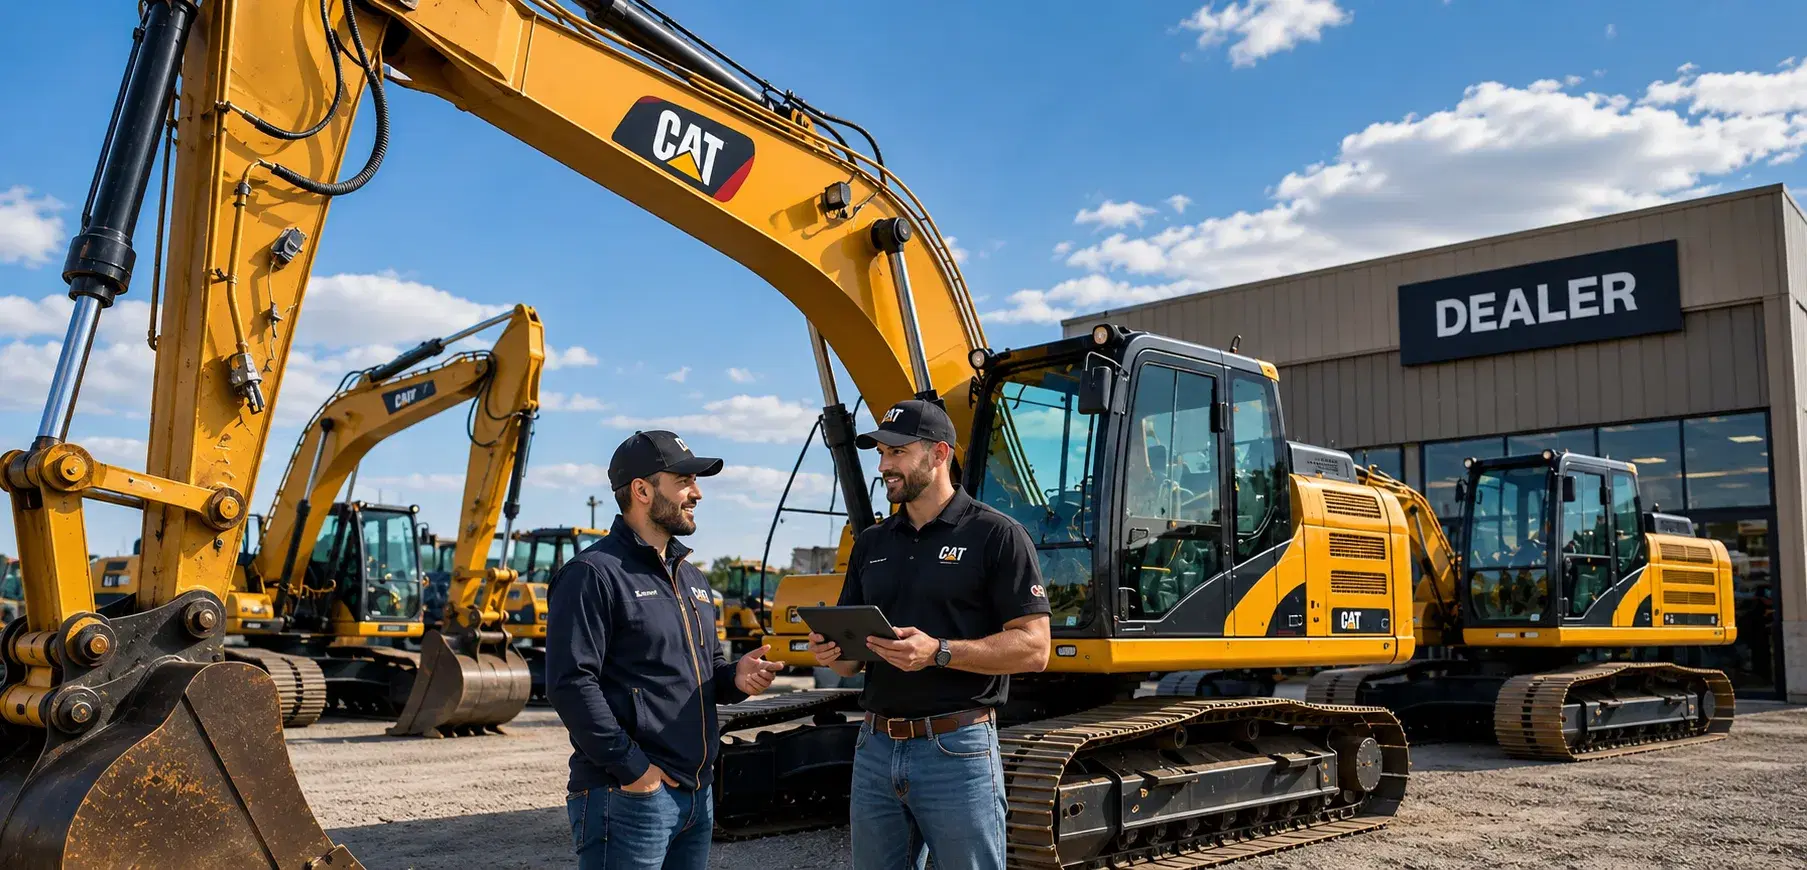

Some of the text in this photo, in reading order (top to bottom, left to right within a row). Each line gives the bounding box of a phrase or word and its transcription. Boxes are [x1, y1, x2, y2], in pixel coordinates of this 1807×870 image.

[652, 109, 725, 186] CAT
[1435, 271, 1638, 338] DEALER
[938, 545, 967, 561] CAT
[1340, 611, 1361, 629] CAT
